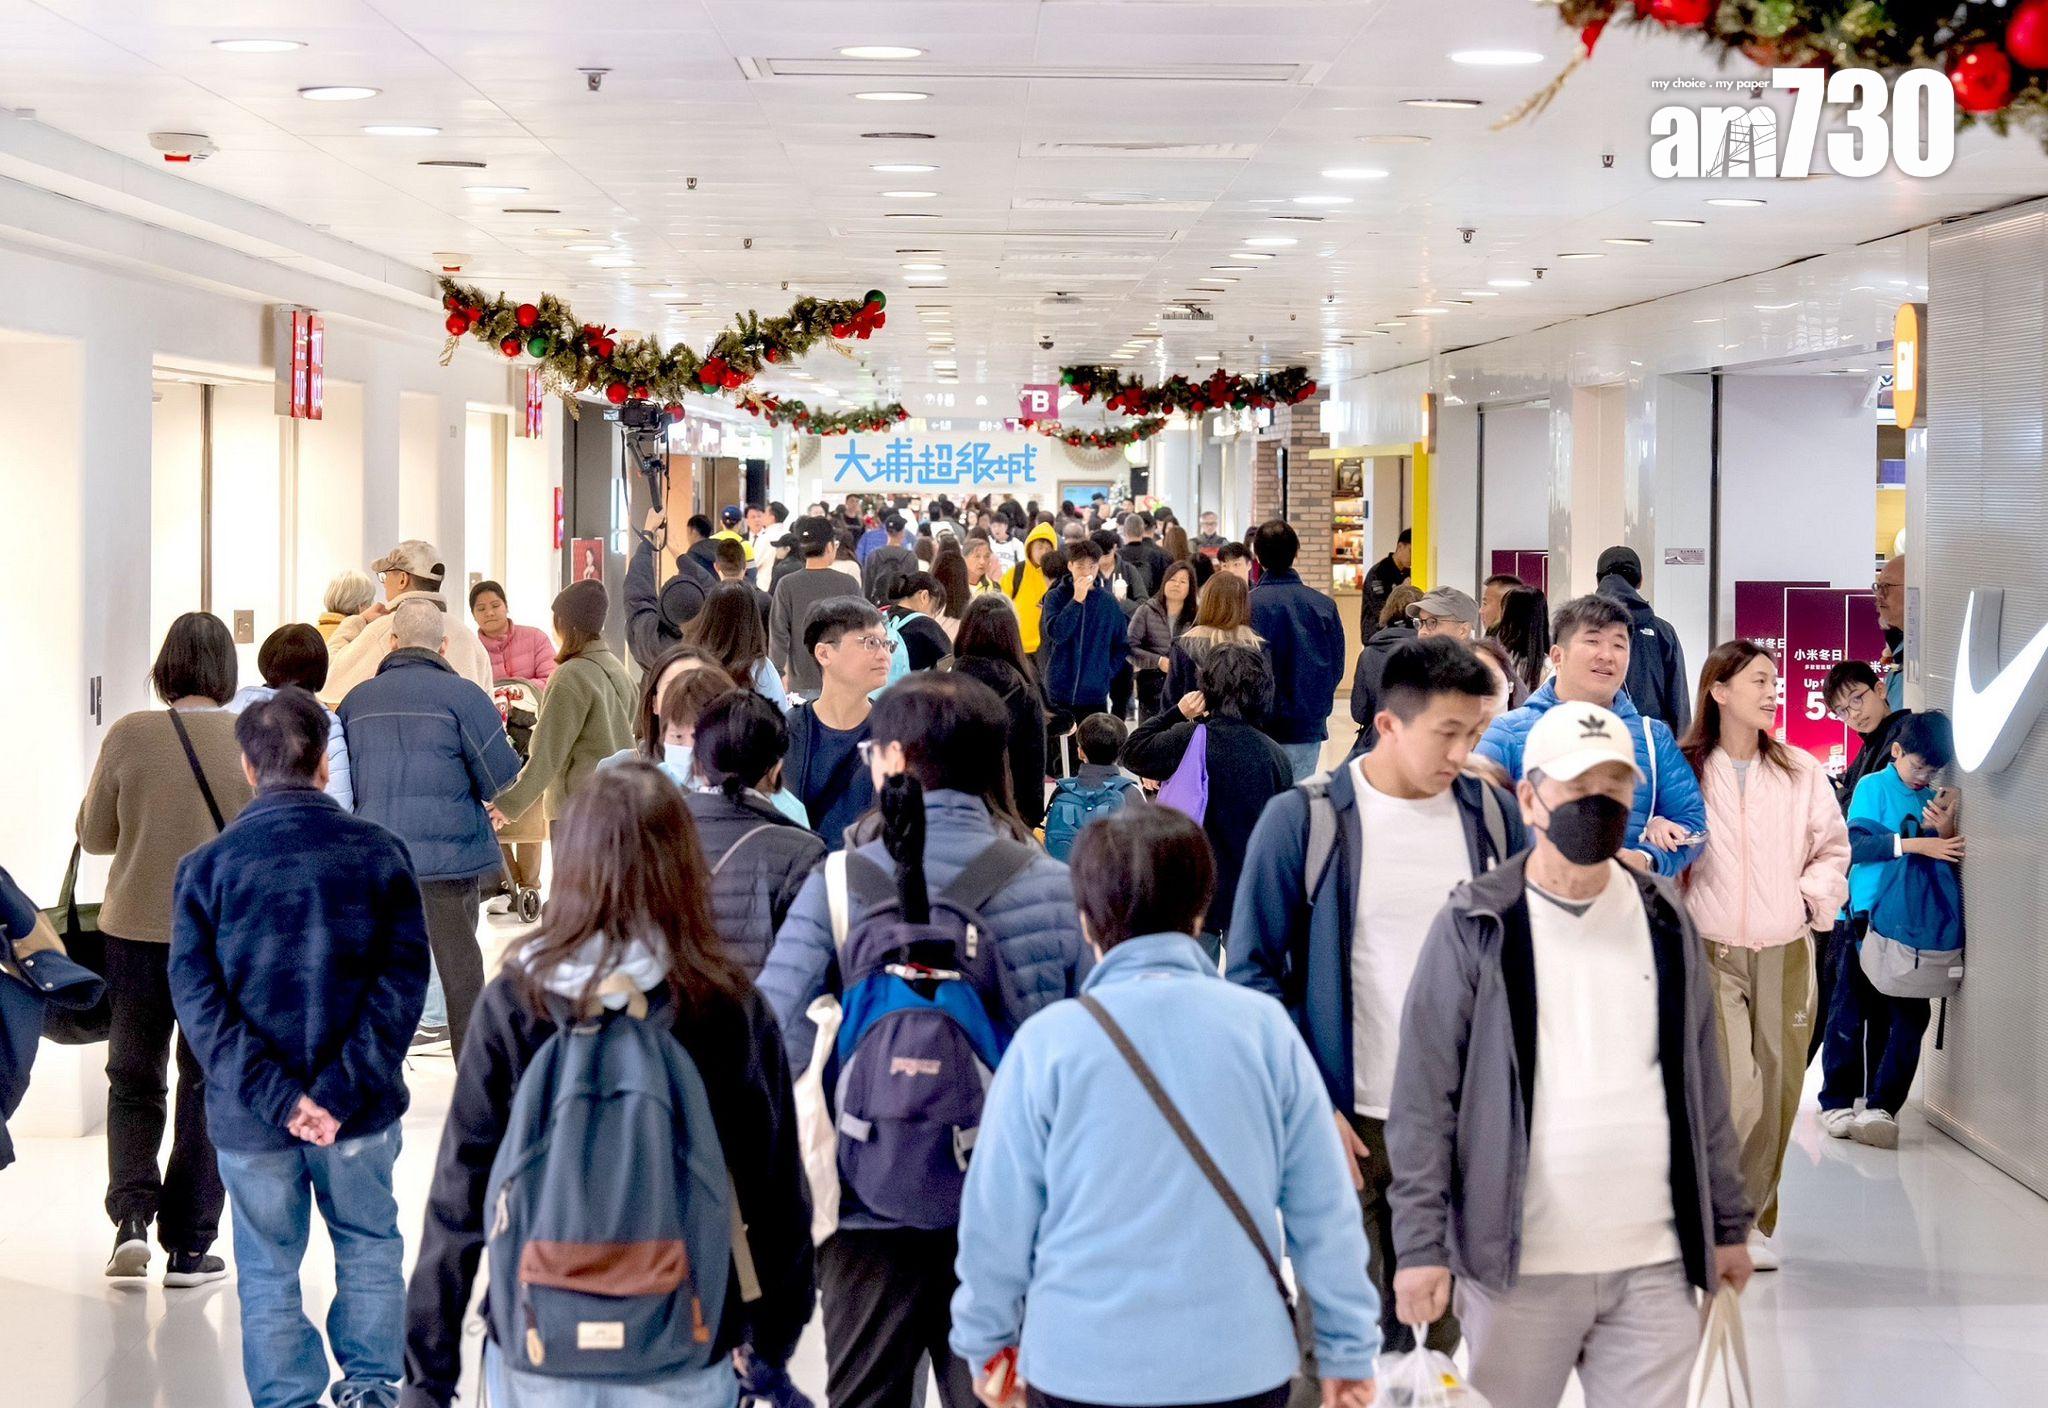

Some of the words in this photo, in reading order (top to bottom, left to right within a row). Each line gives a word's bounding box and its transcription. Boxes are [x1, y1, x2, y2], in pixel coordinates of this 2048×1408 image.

[1747, 638, 1785, 649] 米冬日
[1794, 649, 1842, 661] 小米冬日
[1803, 678, 1819, 690] Up
